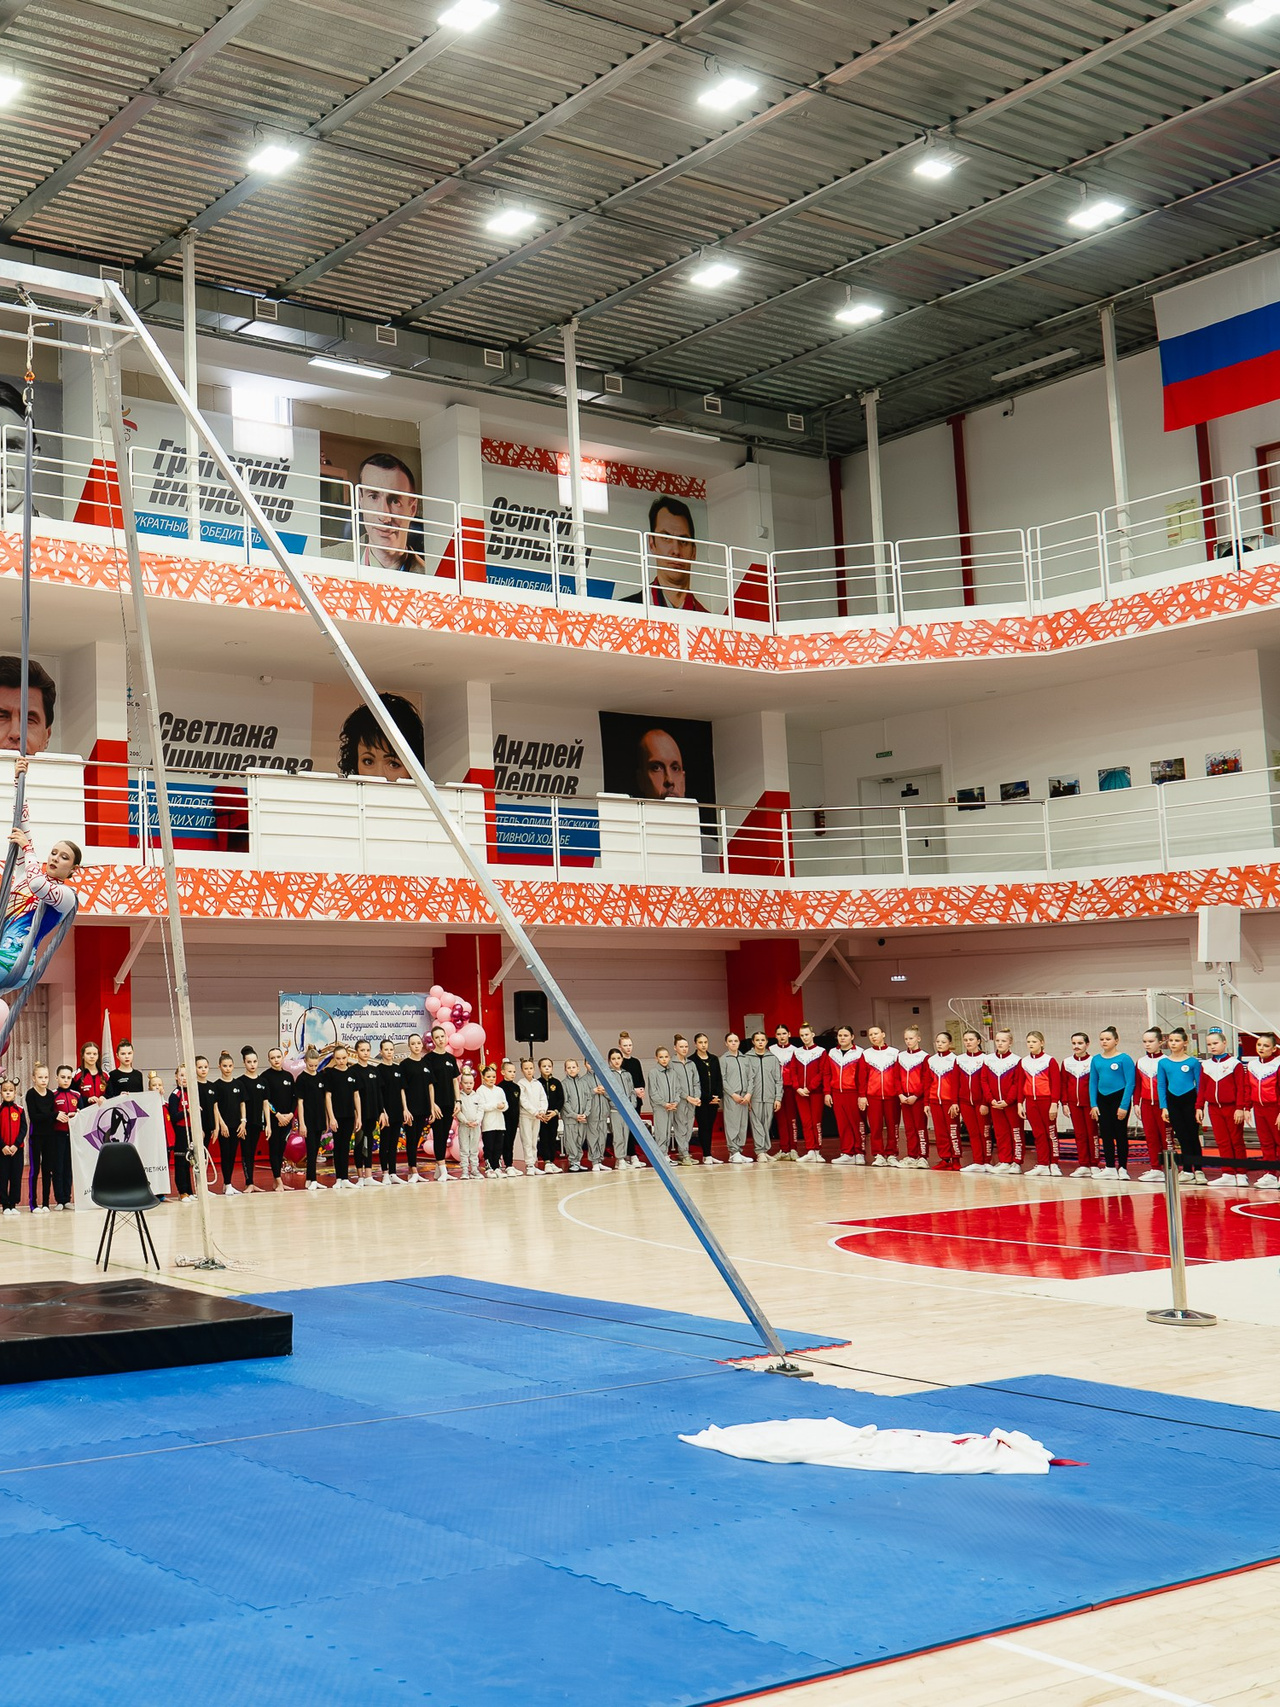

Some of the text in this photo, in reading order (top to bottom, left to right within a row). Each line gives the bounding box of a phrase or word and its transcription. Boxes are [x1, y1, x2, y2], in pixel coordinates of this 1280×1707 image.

[159, 711, 279, 750] Светлана
[493, 733, 584, 771] Андрей
[535, 833, 571, 847] ХОДБЕ
